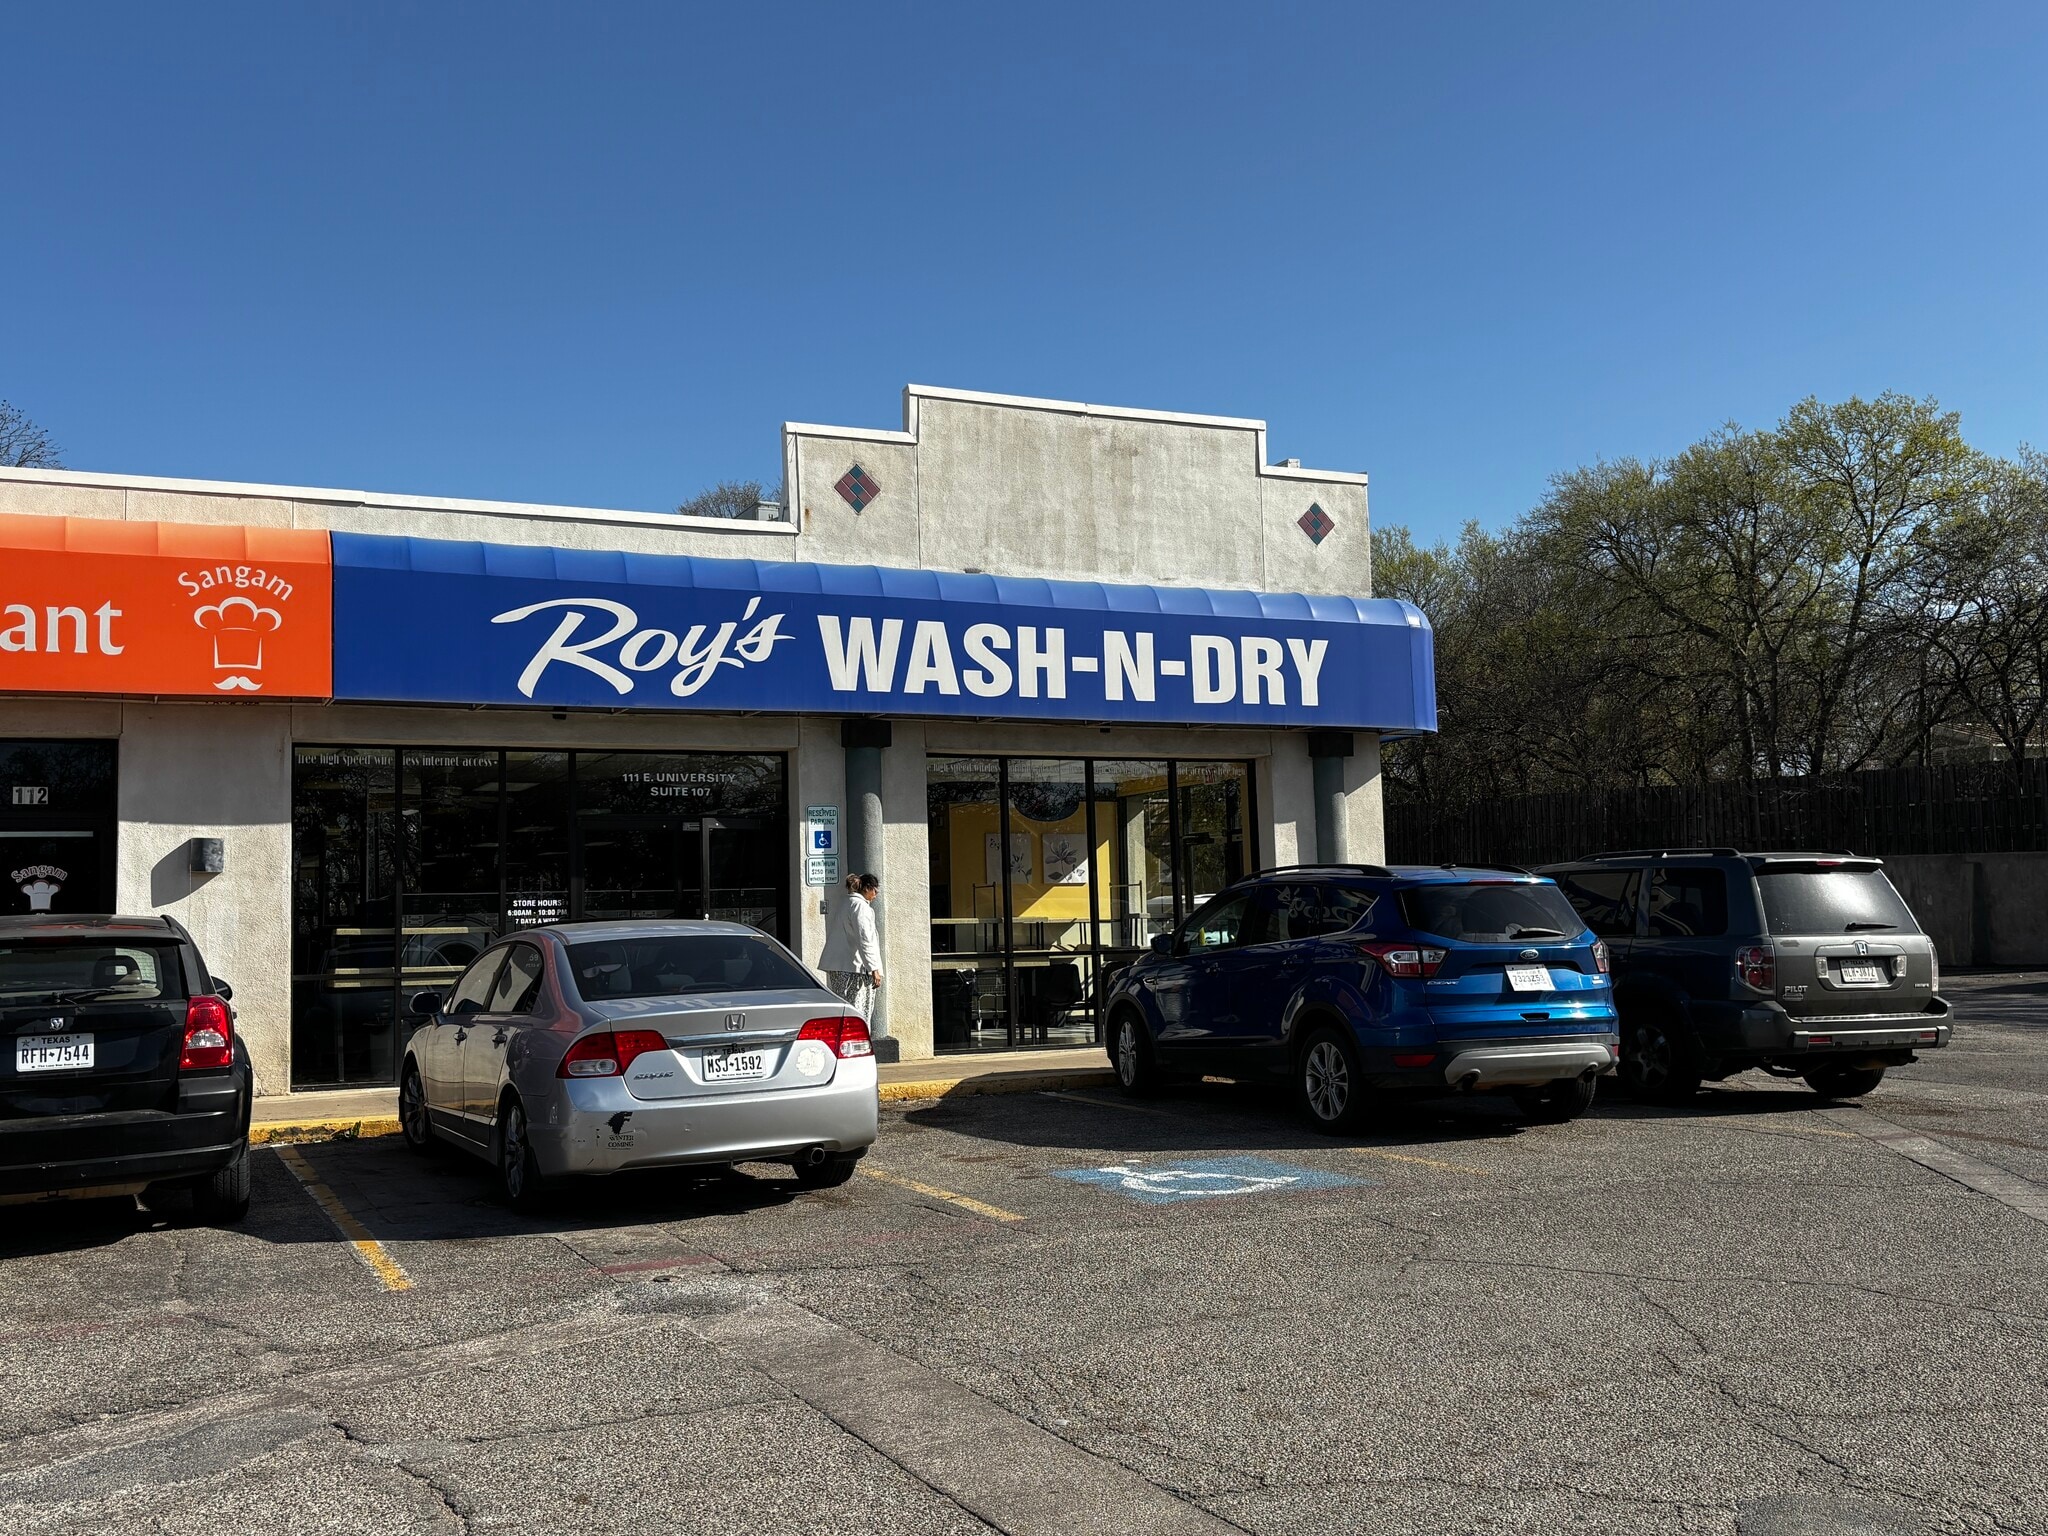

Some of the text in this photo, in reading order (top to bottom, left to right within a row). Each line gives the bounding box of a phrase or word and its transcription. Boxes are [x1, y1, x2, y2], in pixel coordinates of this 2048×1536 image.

[178, 566, 293, 601] Sangam
[0, 600, 125, 655] ant
[491, 597, 1328, 706] Roy's WASH-N-DRY
[298, 753, 316, 764] free
[320, 753, 339, 765] high
[343, 754, 370, 766] speed
[422, 754, 459, 766] internet
[462, 756, 492, 767] access
[622, 773, 639, 782] 111
[656, 773, 736, 783] UNIVERSITY
[15, 787, 48, 804] 112
[650, 786, 711, 797] SUITE 107
[808, 809, 837, 817] RESERVED
[810, 818, 835, 826] PARKING
[11, 865, 68, 883] Sangam
[513, 899, 562, 907] STORE HOURS
[1784, 985, 1808, 993] PILOT
[41, 1036, 71, 1045] TEXAS
